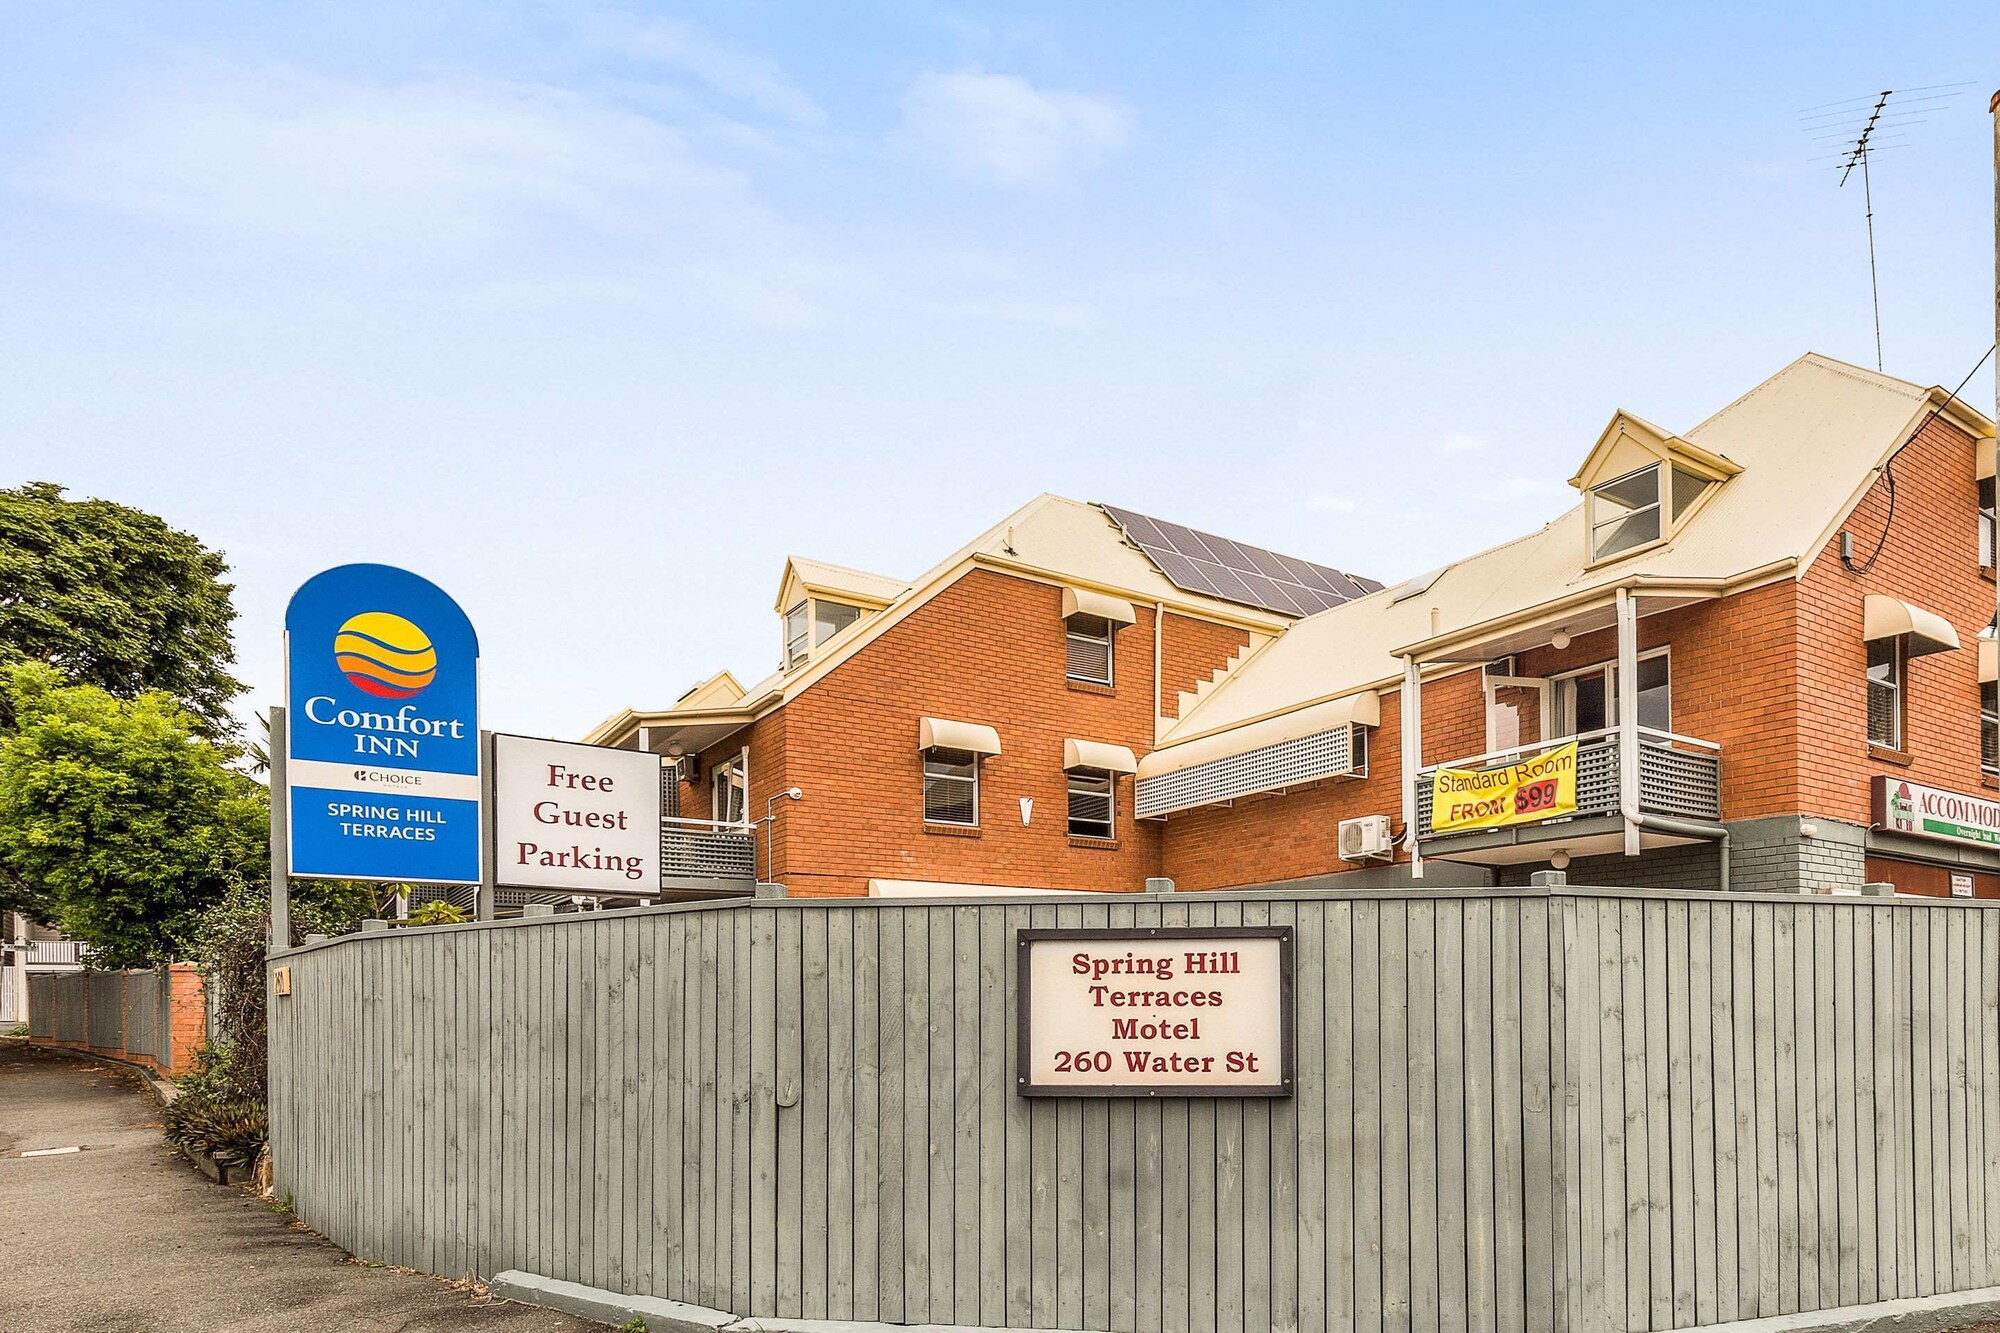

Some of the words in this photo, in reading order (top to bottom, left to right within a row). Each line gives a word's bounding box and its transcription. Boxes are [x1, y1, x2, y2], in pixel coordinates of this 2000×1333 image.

[304, 696, 465, 740] Comfort
[354, 733, 421, 759] INN
[369, 771, 422, 786] CHOICE
[547, 763, 614, 793] Free
[1439, 768, 1510, 794] Standard
[1514, 755, 1572, 783] Room
[328, 803, 400, 822] SPRING
[406, 808, 447, 825] HILL
[533, 801, 628, 831] Guest
[1450, 797, 1506, 822] FROM
[1515, 783, 1555, 811] $99
[339, 822, 436, 842] TERRACES
[517, 841, 644, 880] Parking
[1072, 952, 1174, 981] Spring
[1183, 951, 1241, 975] Hill
[1088, 985, 1223, 1007] Terraces
[1111, 1017, 1201, 1040] Motel
[1054, 1050, 1112, 1073] 260
[1122, 1051, 1215, 1073] Water
[1225, 1051, 1259, 1073] St
